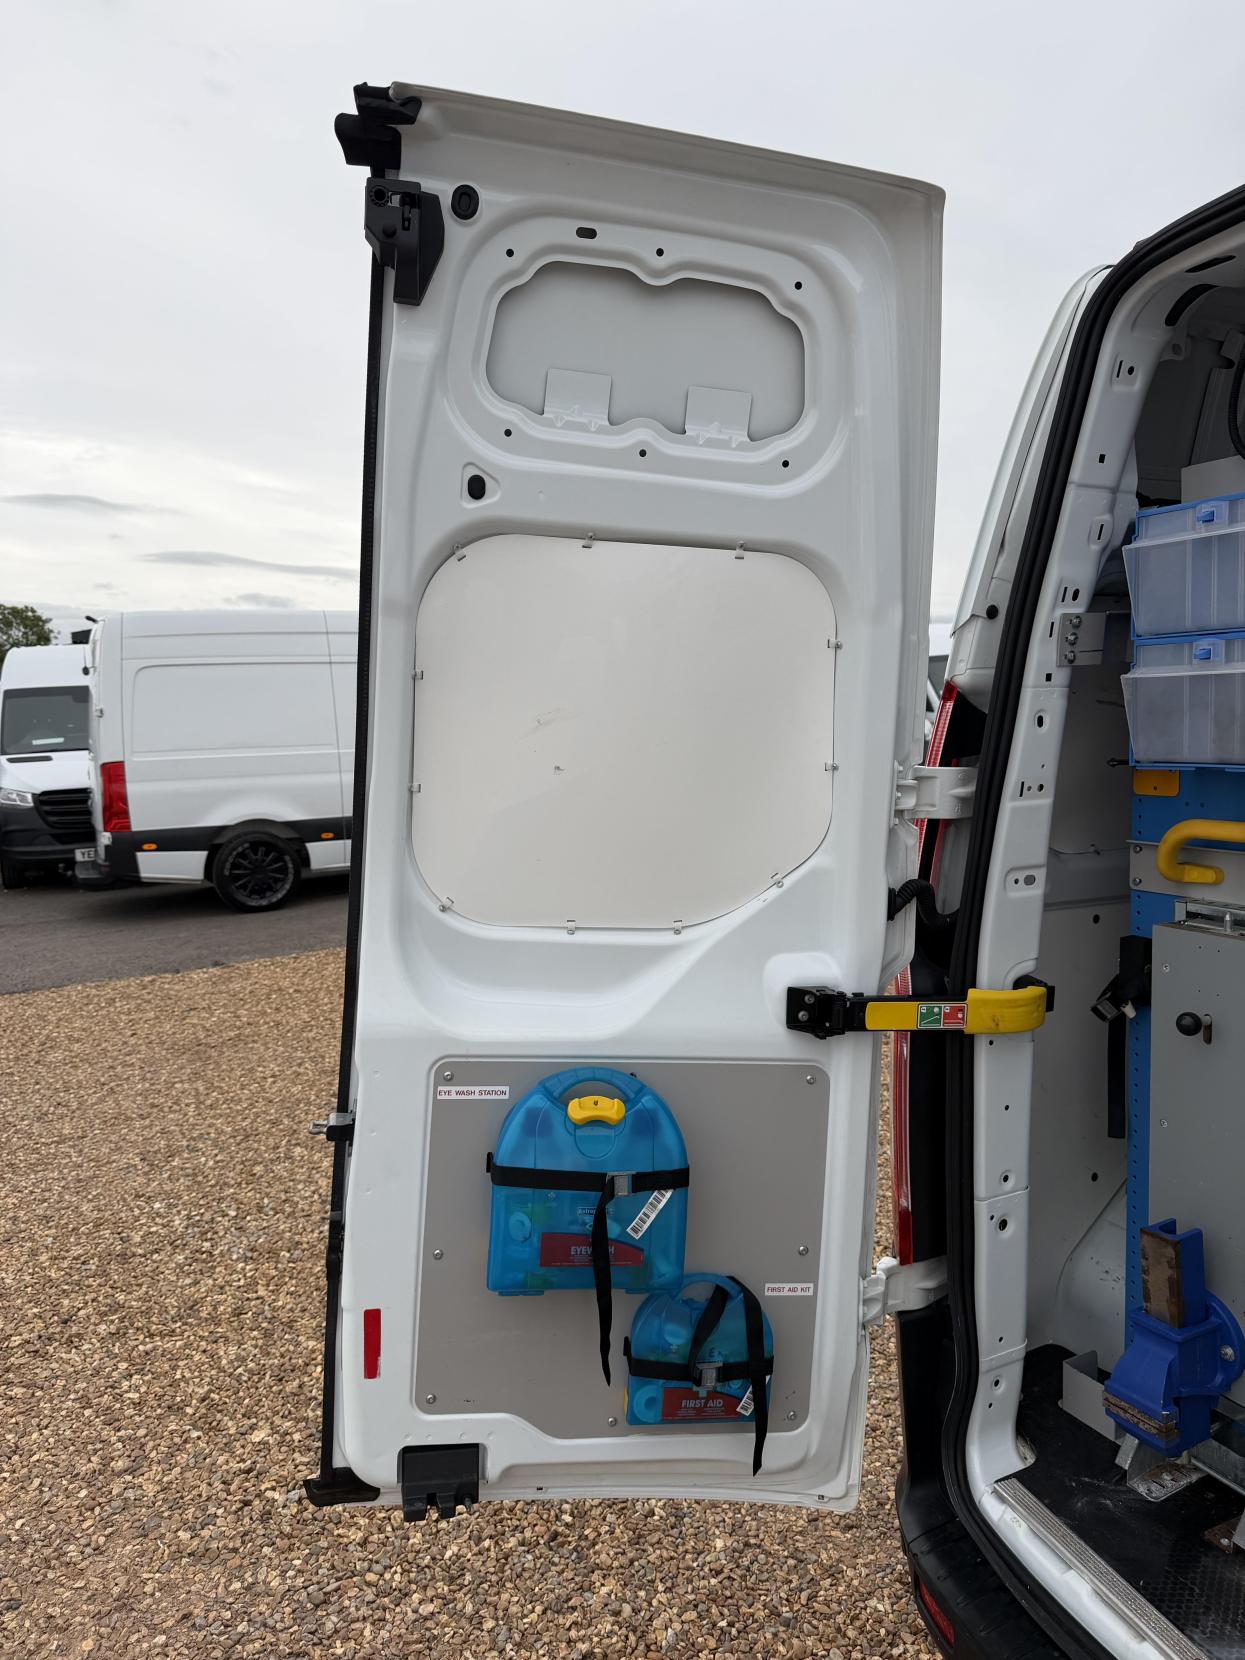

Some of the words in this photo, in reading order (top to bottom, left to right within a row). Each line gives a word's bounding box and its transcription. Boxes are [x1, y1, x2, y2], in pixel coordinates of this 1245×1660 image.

[438, 1089, 452, 1097] EYE
[455, 1089, 476, 1097] WASH
[478, 1089, 507, 1097] STATION
[570, 1246, 615, 1255] EYEWH
[681, 1399, 705, 1408] FIRST
[707, 1399, 724, 1407] AID
